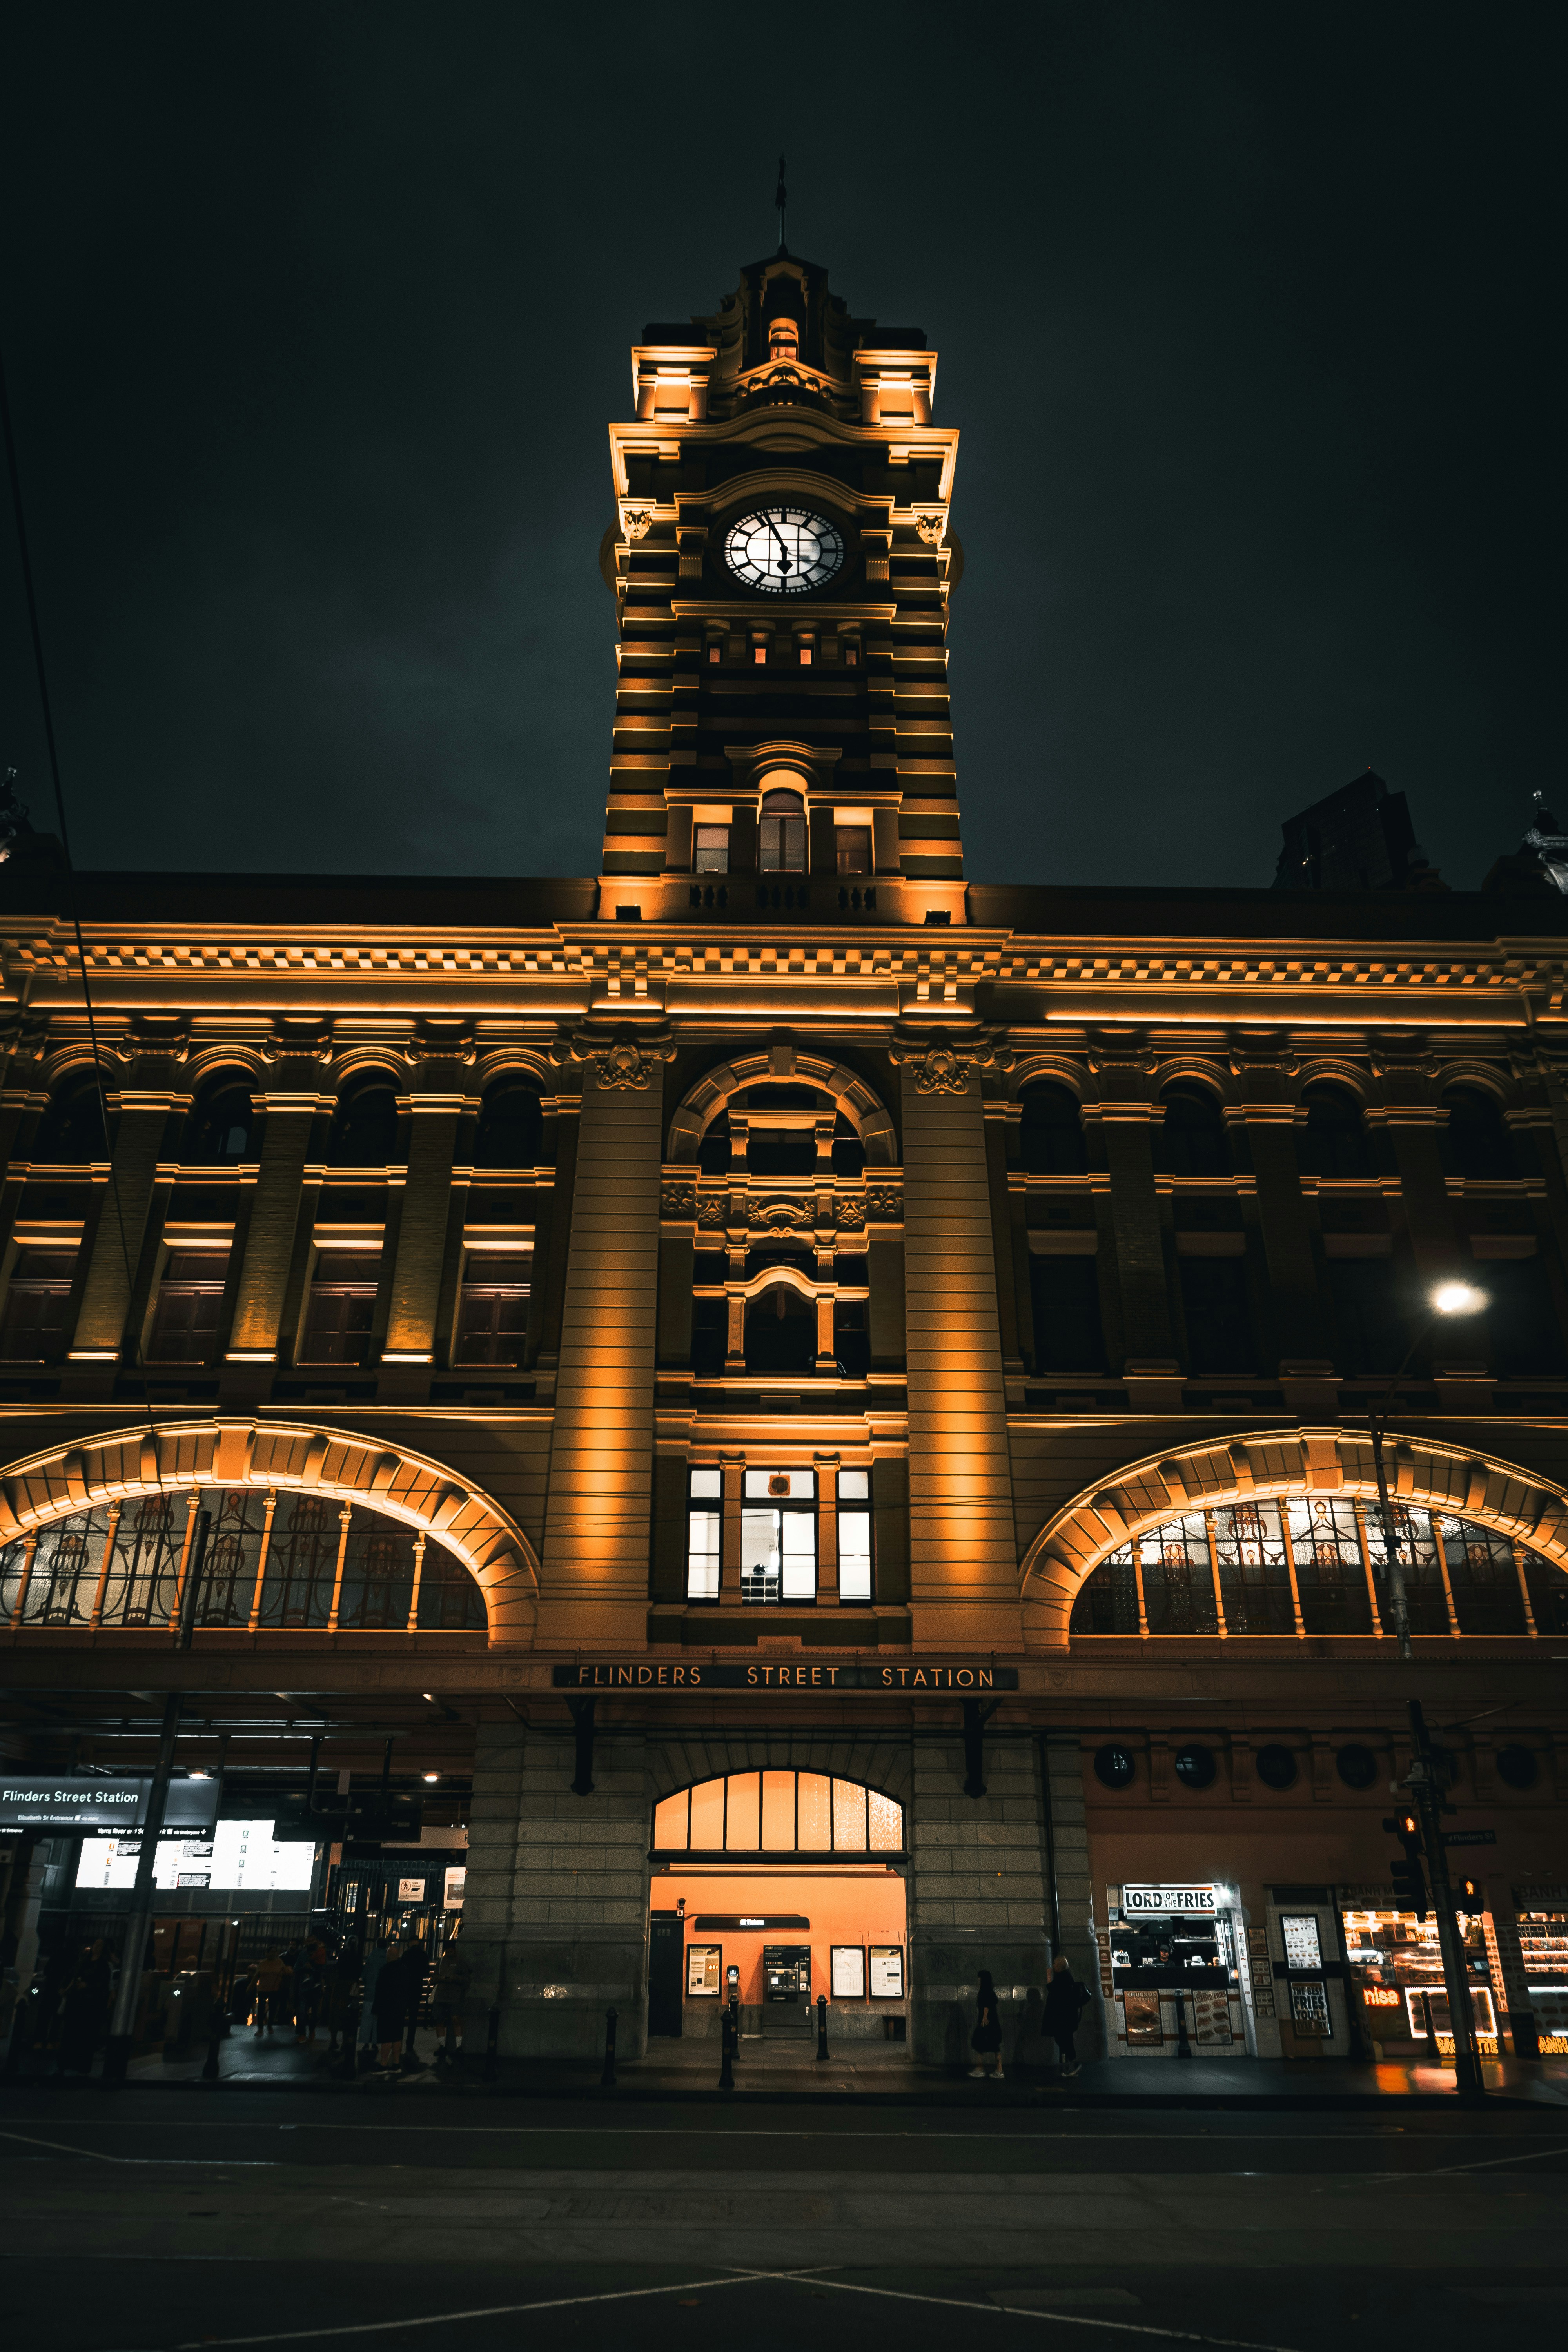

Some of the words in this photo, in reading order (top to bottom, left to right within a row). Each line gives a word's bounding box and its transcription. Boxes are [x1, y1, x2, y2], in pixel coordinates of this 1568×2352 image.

[579, 1667, 701, 1684] FLINDERS
[748, 1667, 839, 1685] STREET
[882, 1668, 993, 1686] STATION
[2, 1790, 50, 1801] Flinders
[54, 1791, 91, 1802] Street
[95, 1791, 138, 1802] Station
[1125, 1893, 1162, 1907] LORD
[1177, 1893, 1214, 1908] FRIES
[1307, 1987, 1322, 1995] BEST
[1364, 1986, 1399, 2004] nisa
[1294, 1996, 1325, 2010] FRIES
[1296, 2010, 1326, 2020] YOU'LL
